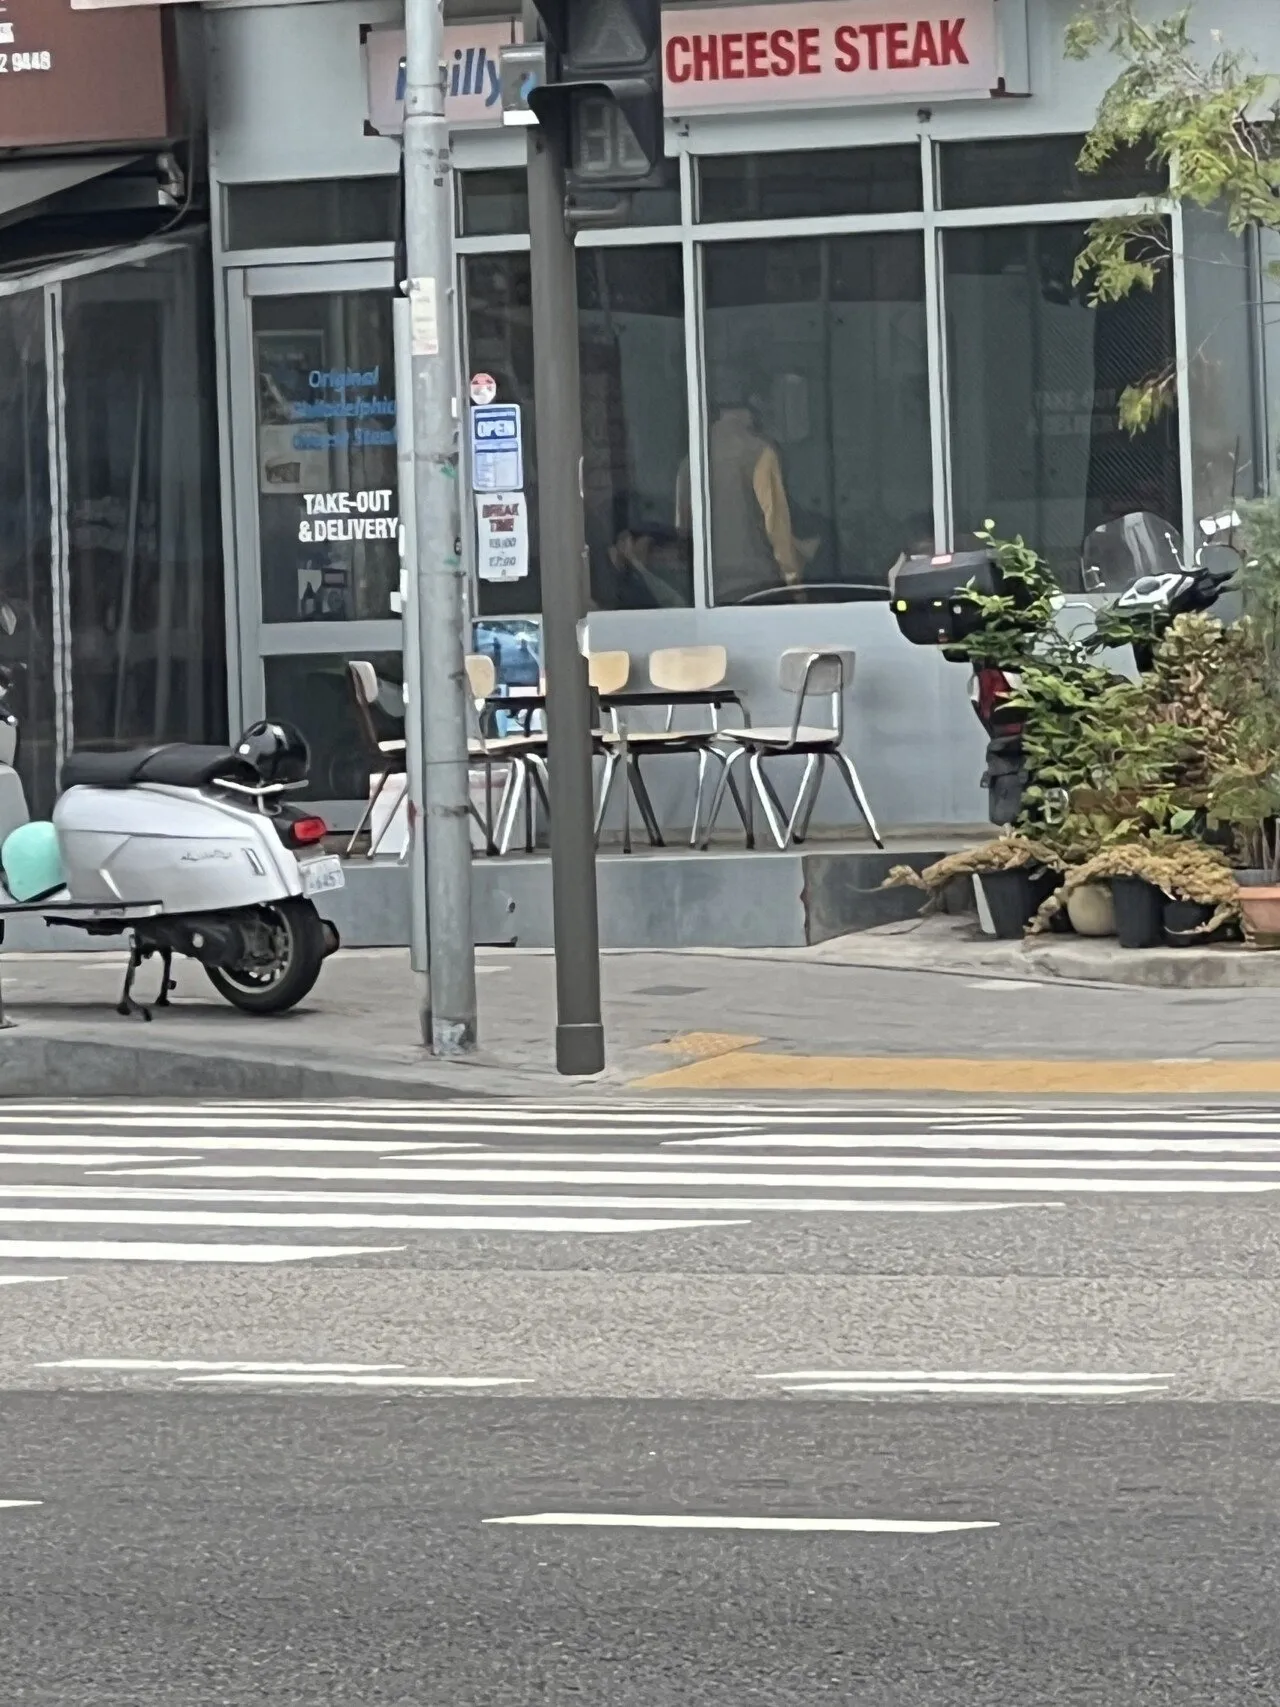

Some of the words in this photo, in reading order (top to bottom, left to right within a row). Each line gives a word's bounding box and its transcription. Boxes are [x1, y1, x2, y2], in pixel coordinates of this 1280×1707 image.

[666, 28, 821, 83] CHEESE
[834, 18, 969, 72] STEAK
[396, 47, 501, 107] illy
[477, 419, 516, 438] OPEN
[303, 489, 393, 515] TAKE-OUT
[482, 503, 519, 518] BREAK
[298, 520, 313, 542] &
[314, 517, 399, 542] DELIVERY
